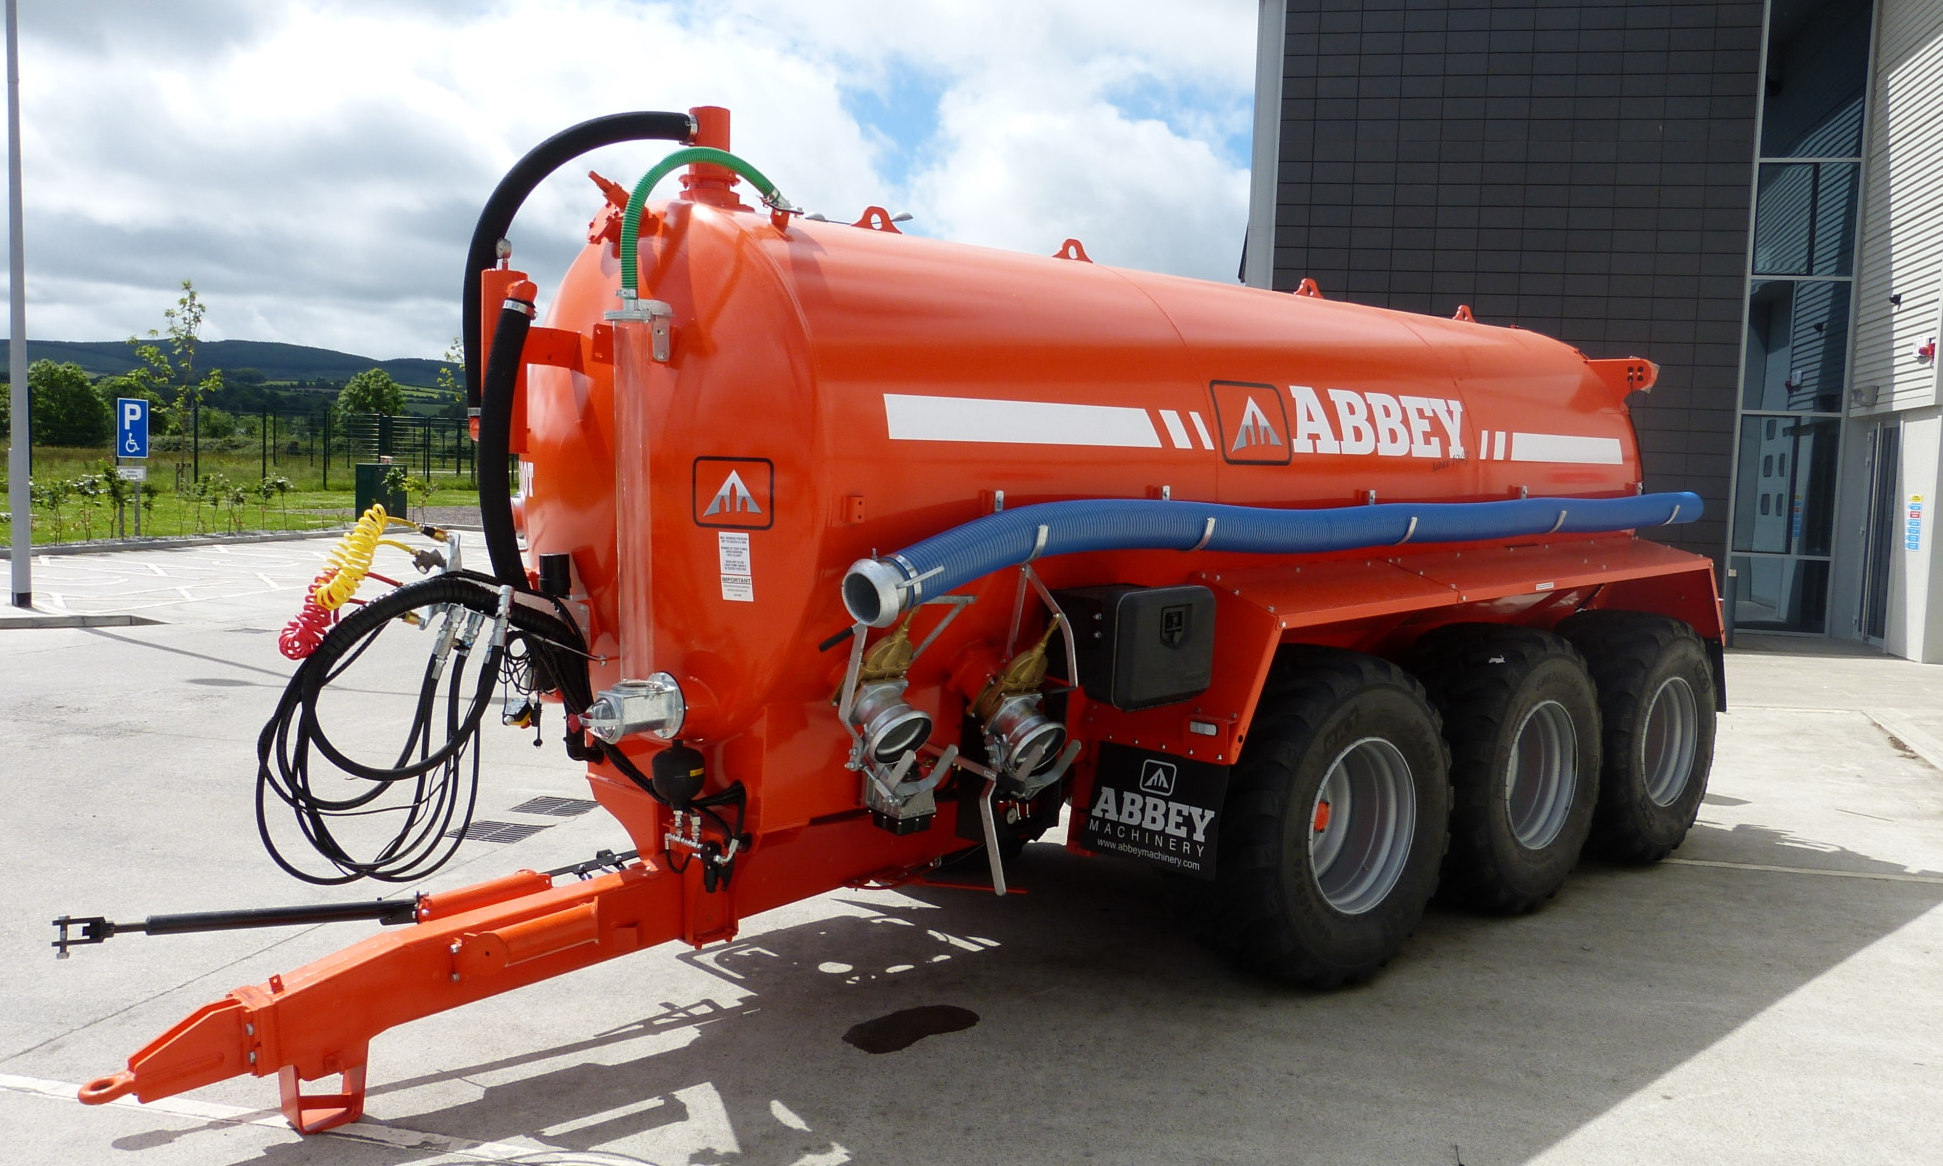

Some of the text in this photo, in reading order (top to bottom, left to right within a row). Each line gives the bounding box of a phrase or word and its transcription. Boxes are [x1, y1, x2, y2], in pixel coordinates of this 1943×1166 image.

[124, 403, 142, 430] P
[1289, 385, 1463, 459] ABBEY
[1091, 786, 1215, 842] ABBEY
[1089, 819, 1205, 857] MACHINERY
[1097, 837, 1200, 871] www.abbeymachinery.com
